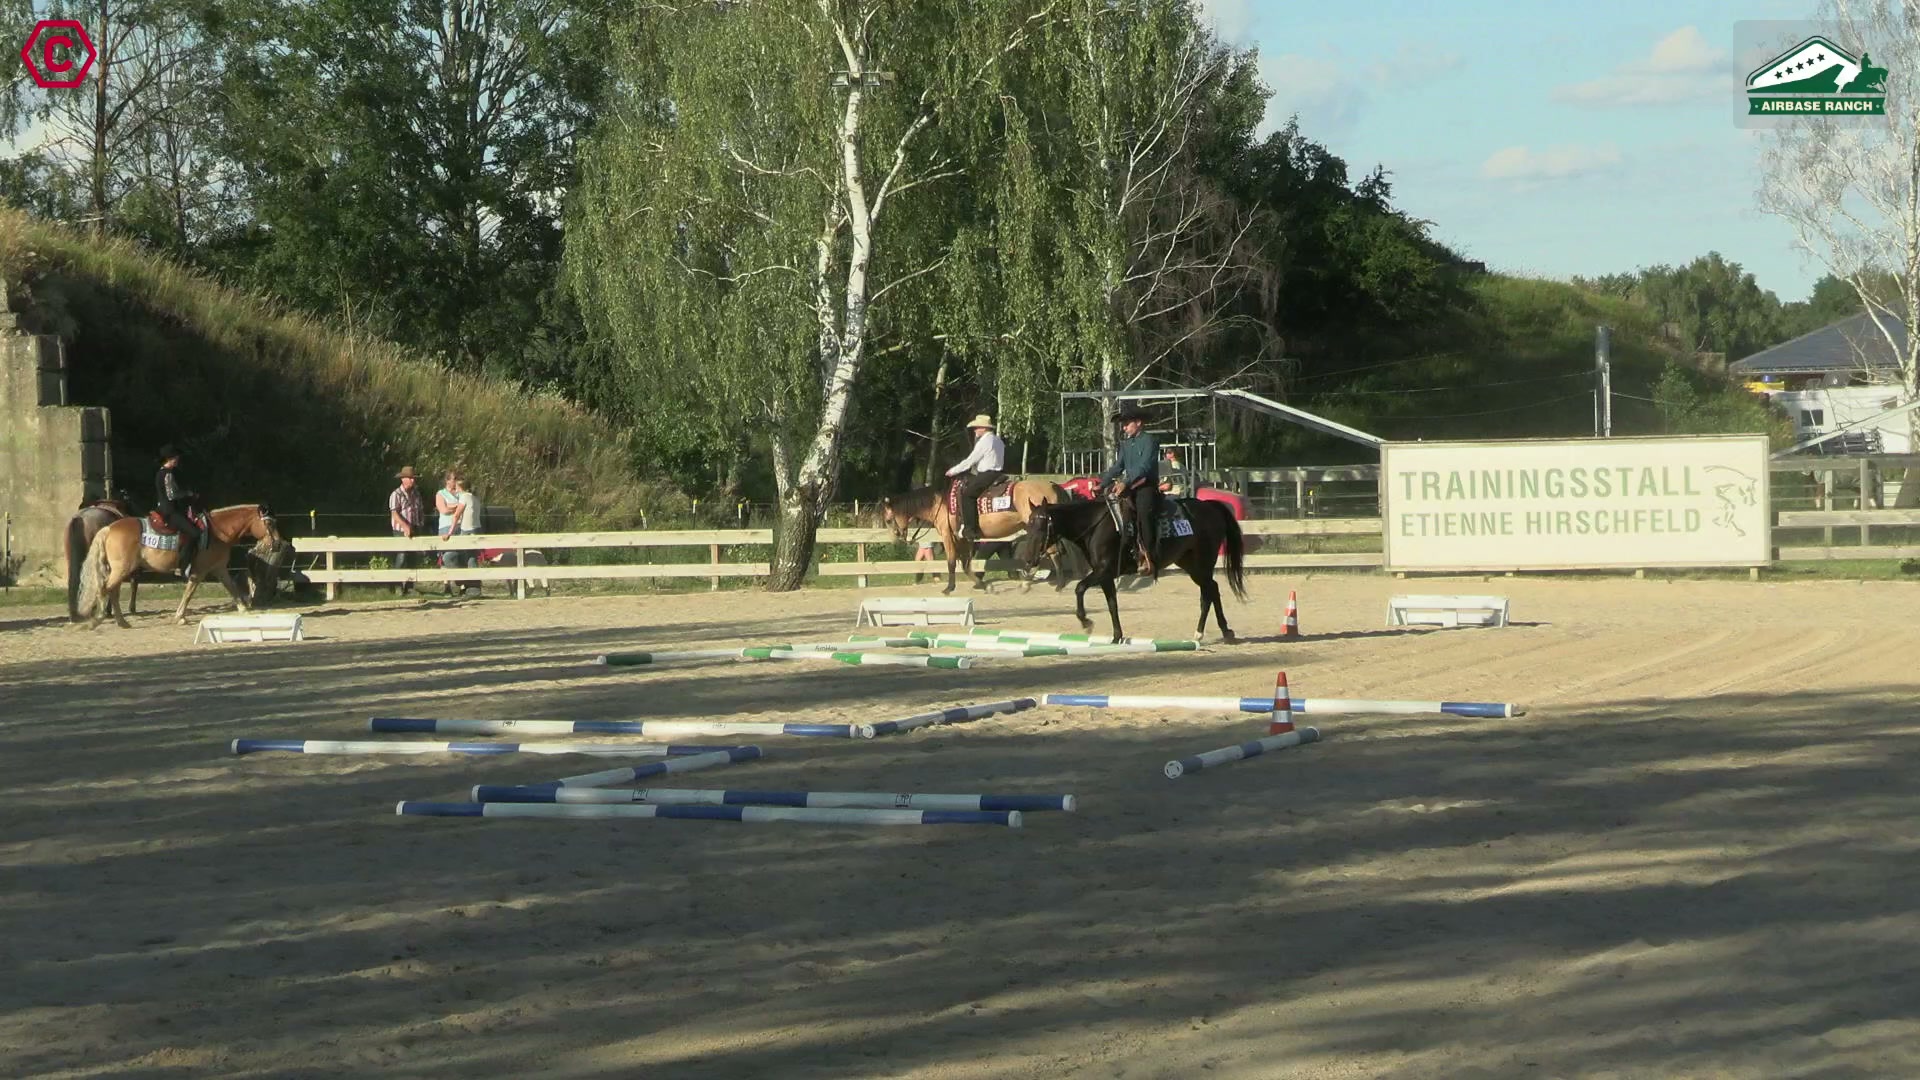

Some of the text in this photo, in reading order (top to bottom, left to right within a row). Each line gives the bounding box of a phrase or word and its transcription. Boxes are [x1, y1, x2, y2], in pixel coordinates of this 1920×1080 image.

[1399, 465, 1701, 500] TRAININGSSTALL
[1401, 508, 1701, 537] ETIENNE HIRSCHFELD
[143, 535, 157, 546] 110
